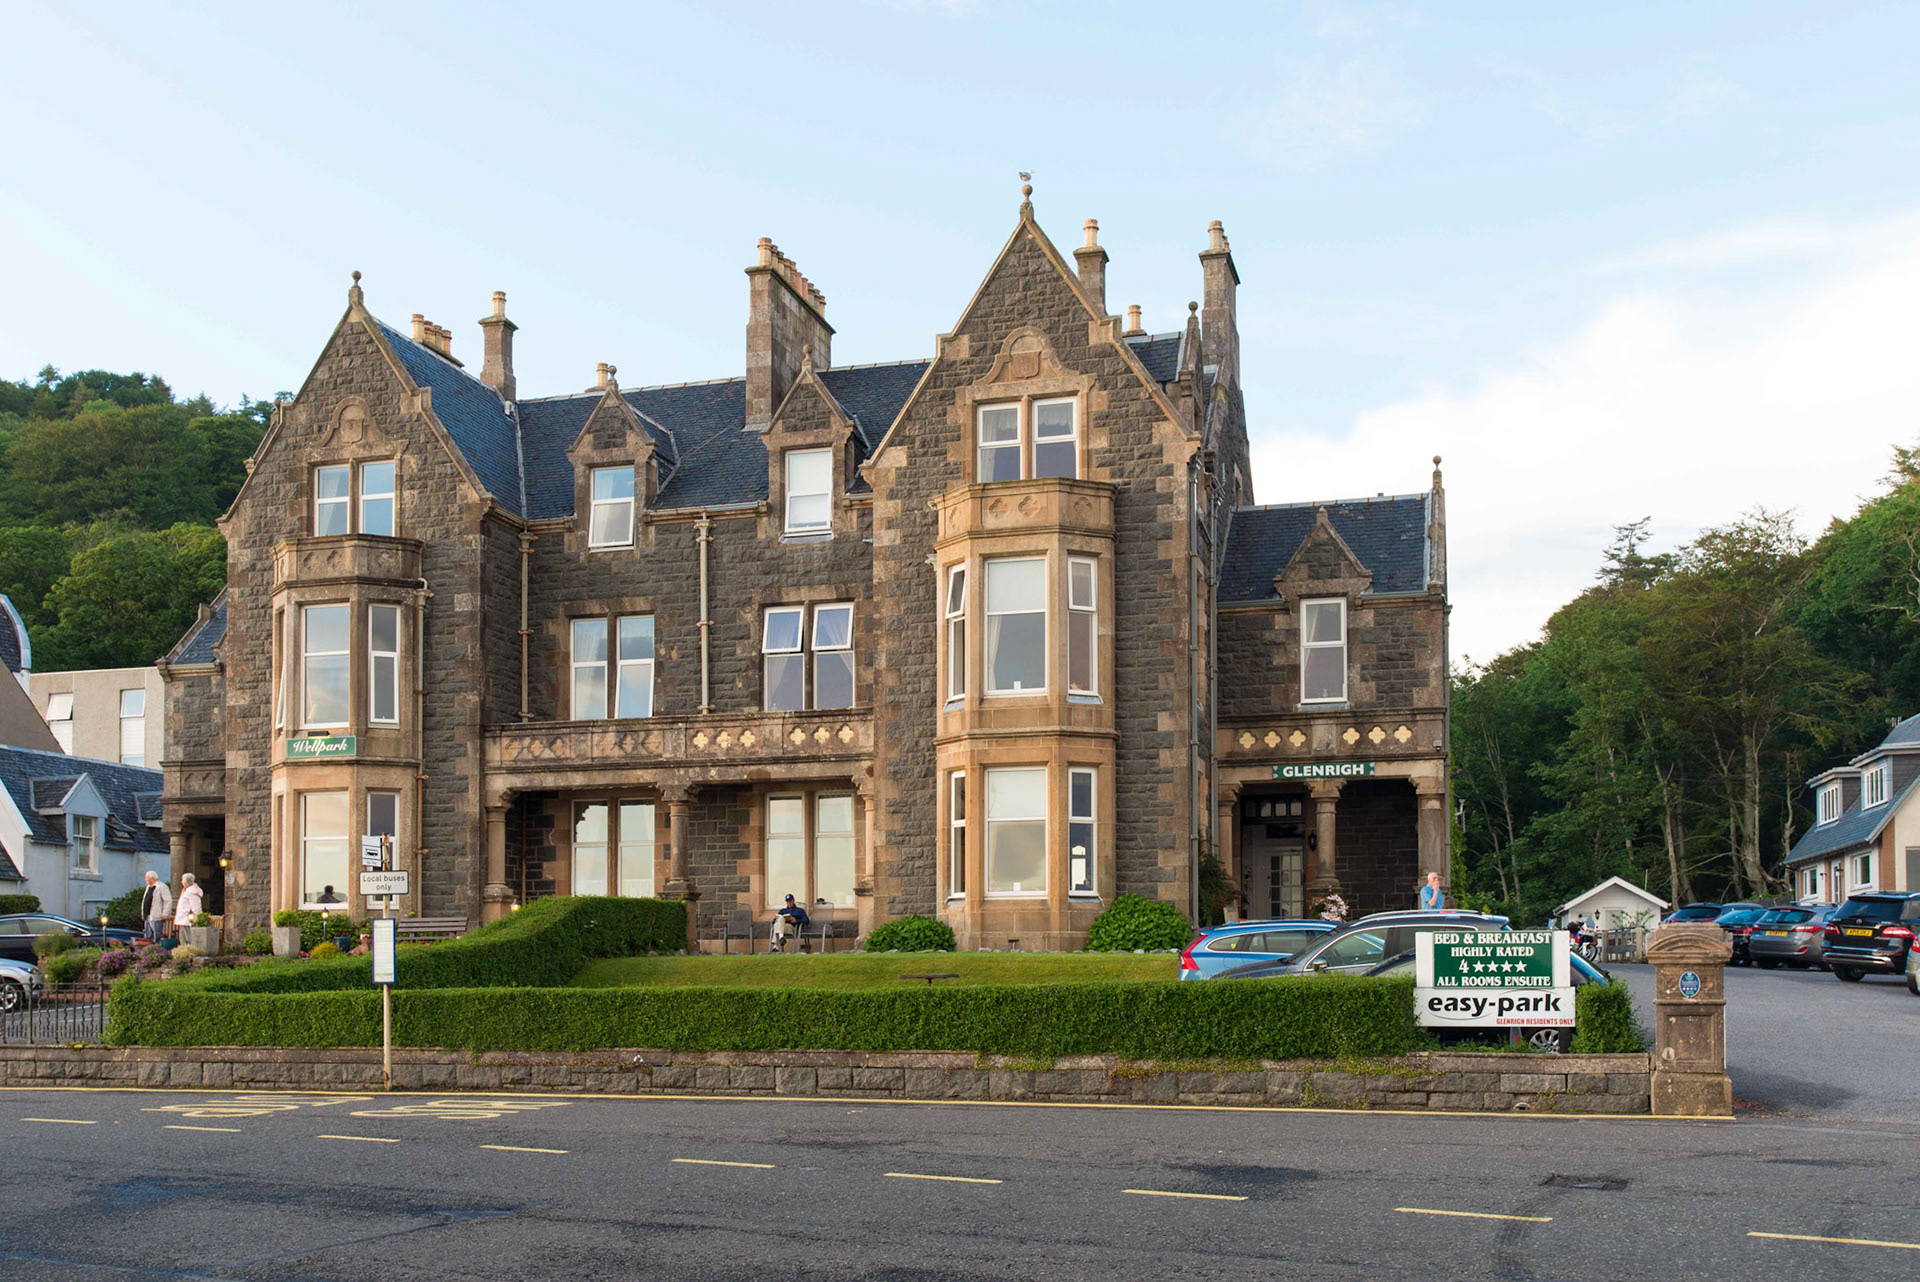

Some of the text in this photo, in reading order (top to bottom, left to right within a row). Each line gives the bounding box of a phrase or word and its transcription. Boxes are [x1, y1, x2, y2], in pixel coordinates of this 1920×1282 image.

[292, 738, 349, 756] Wellpark
[1282, 763, 1364, 777] GLENRIGH
[1434, 932, 1552, 944] BED & BREAKFAST
[1450, 946, 1534, 957] HIGHLY RATED
[1458, 959, 1469, 973] 4
[1436, 976, 1551, 986] ALL ROOMS ENSUITE
[1428, 993, 1561, 1017] easy-park
[349, 1099, 575, 1120] BUS
